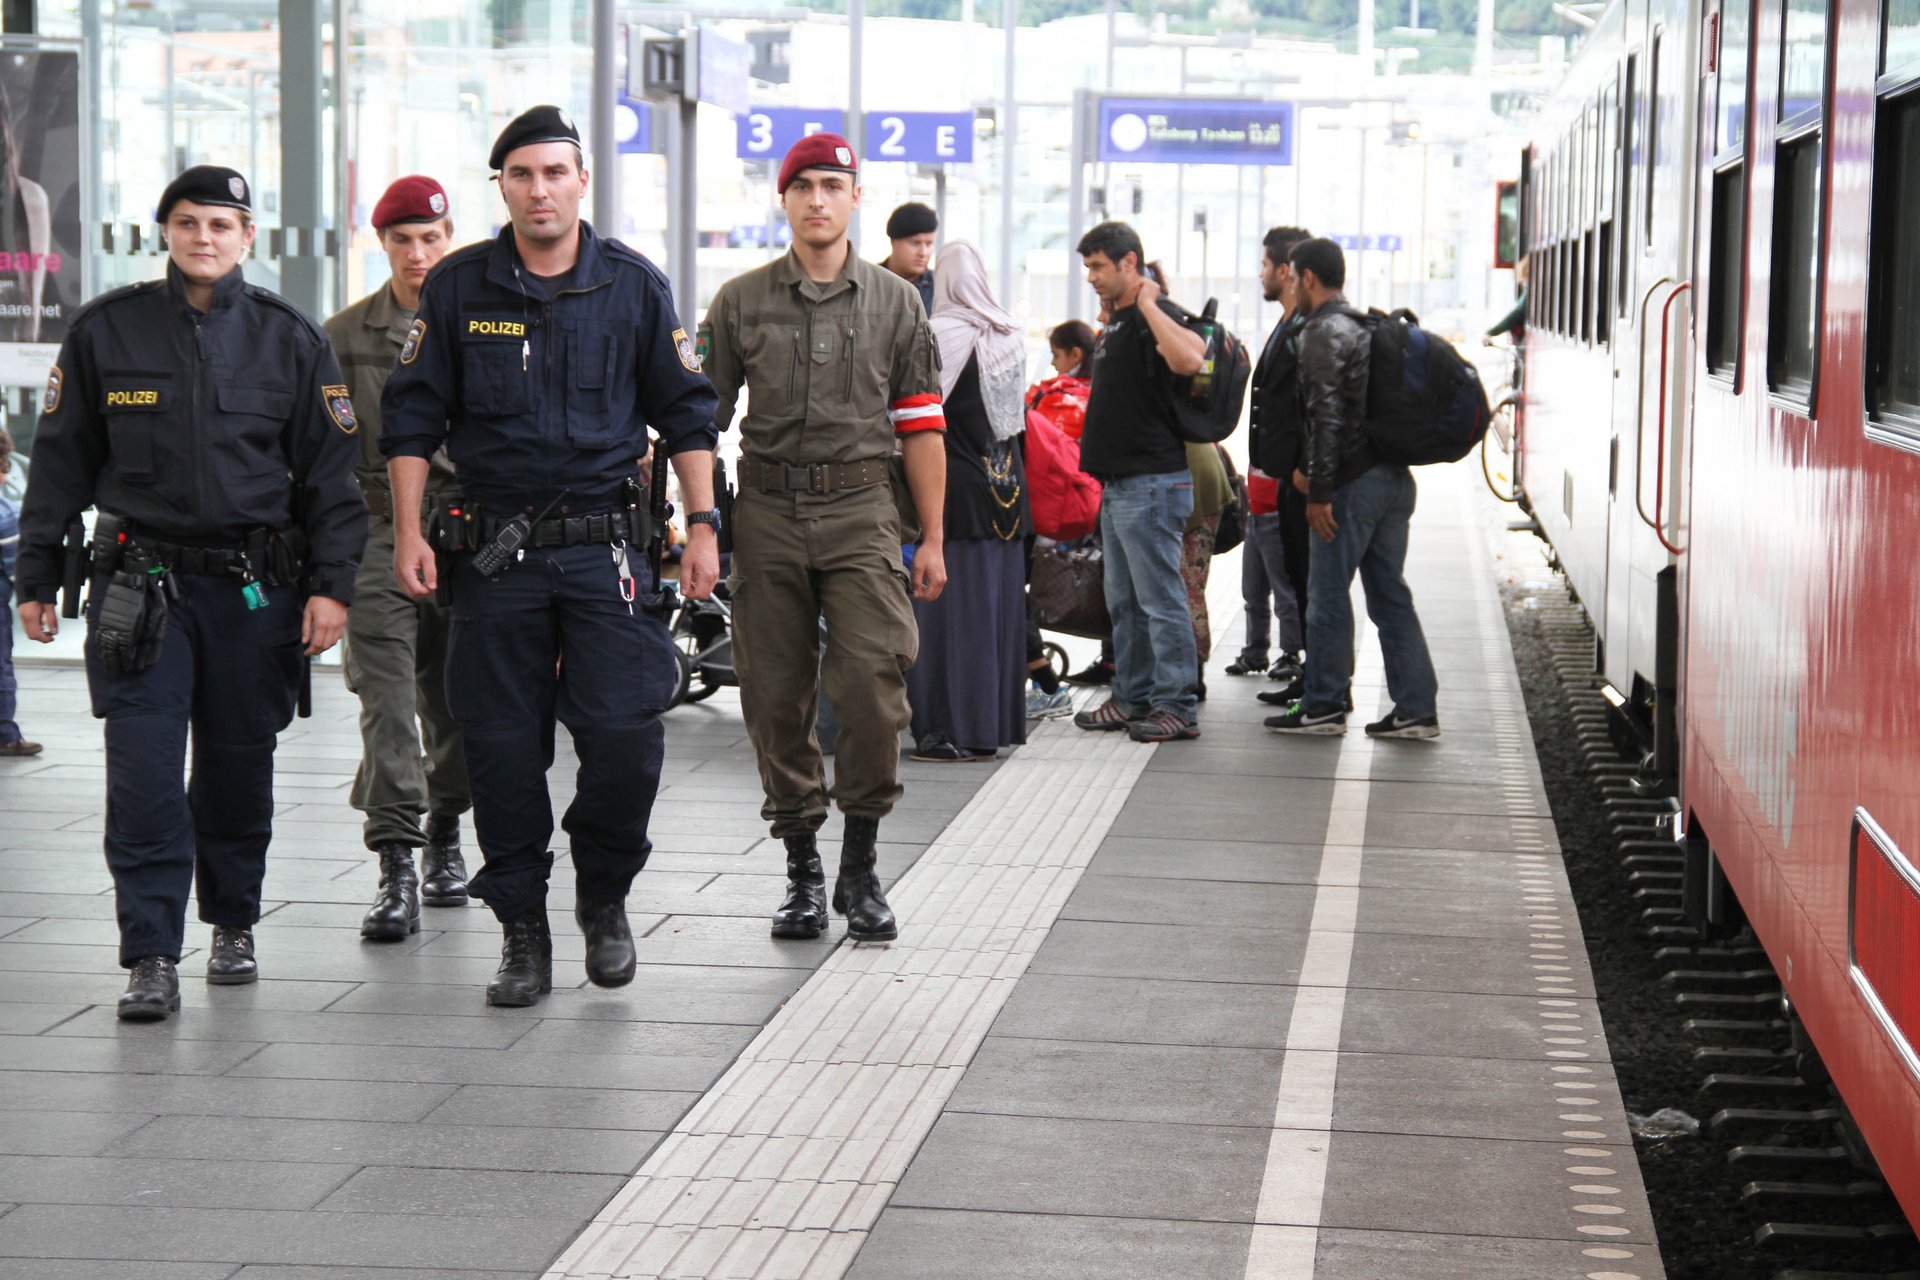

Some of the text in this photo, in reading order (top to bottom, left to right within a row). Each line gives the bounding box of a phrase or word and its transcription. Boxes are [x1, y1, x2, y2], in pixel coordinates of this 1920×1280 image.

[748, 113, 773, 152] 3
[880, 116, 956, 156] 2 E
[468, 320, 525, 336] POLIZEI
[107, 391, 158, 406] POLIZEI
